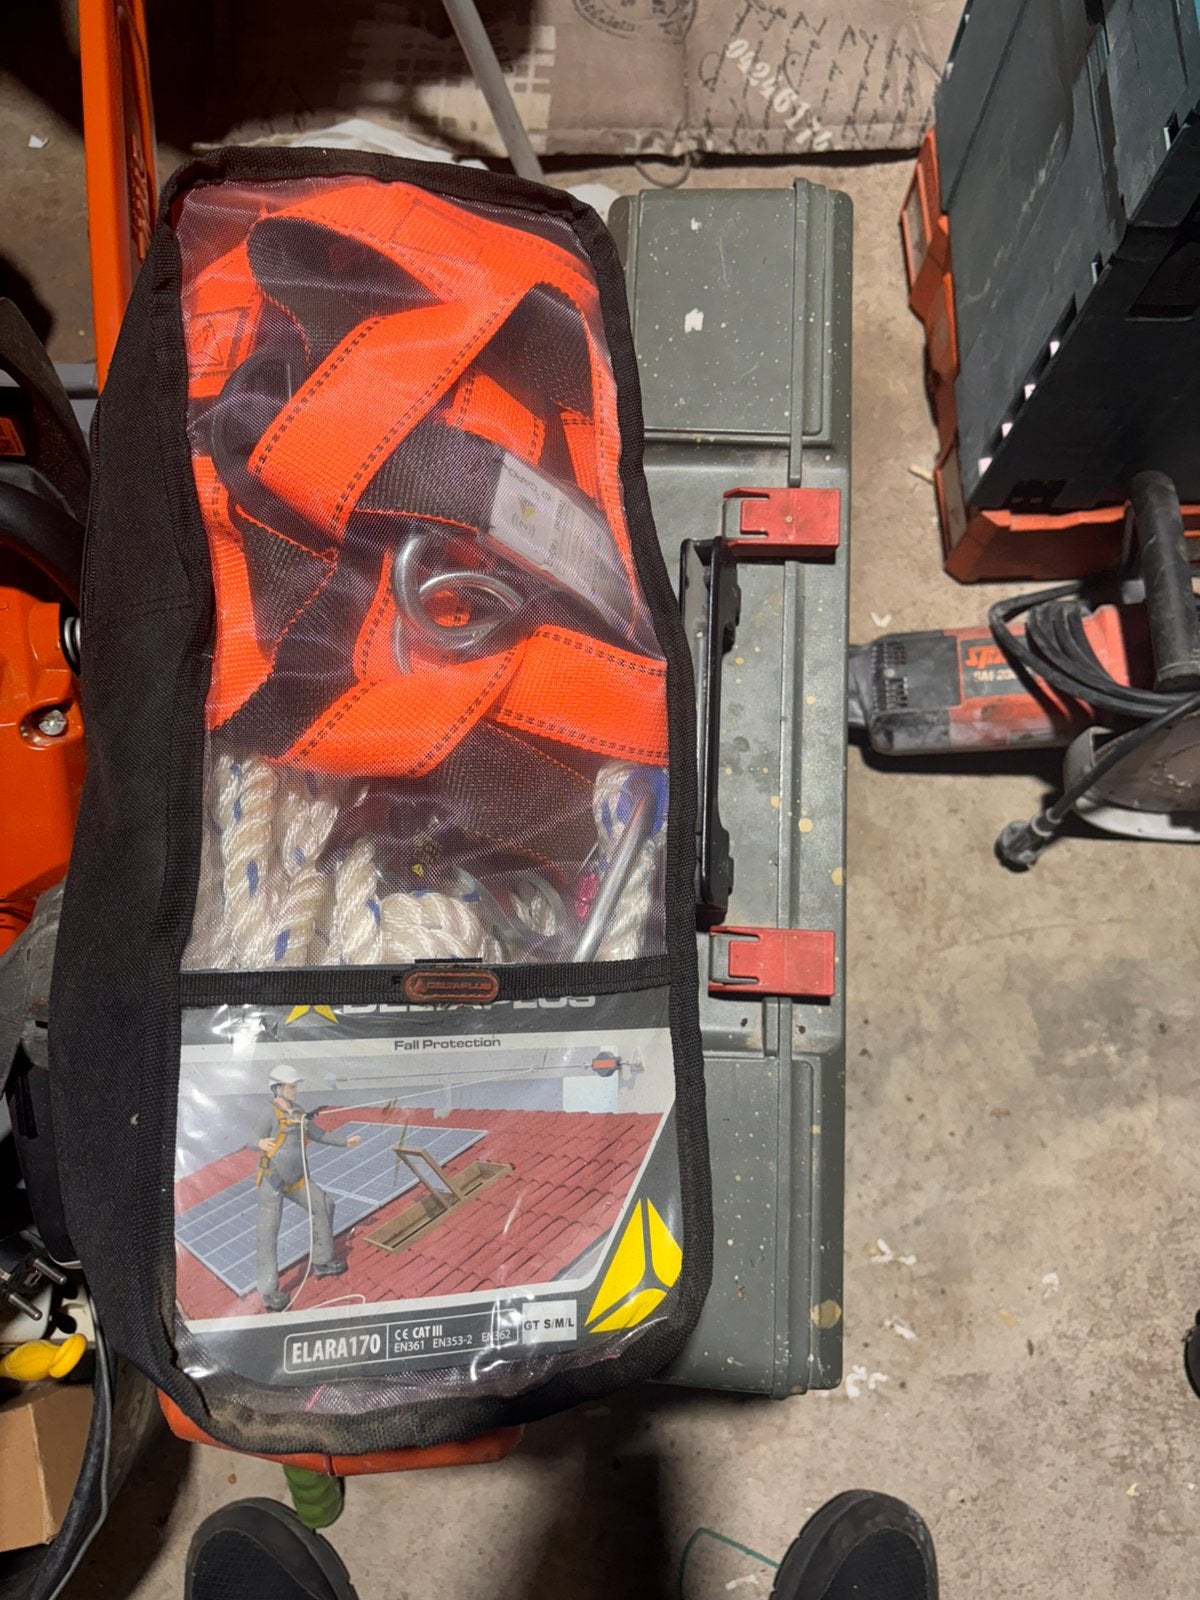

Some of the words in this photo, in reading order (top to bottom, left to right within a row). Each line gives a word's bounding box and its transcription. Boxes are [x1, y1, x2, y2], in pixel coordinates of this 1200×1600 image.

[394, 1039, 419, 1050] Fall
[422, 1037, 501, 1050] Protection
[523, 1320, 540, 1331] GT
[544, 1317, 575, 1329] S/M/L
[394, 1328, 408, 1341] CE
[412, 1327, 430, 1339] CAT
[432, 1325, 443, 1337] III
[394, 1341, 425, 1353] EN361
[433, 1335, 473, 1348] EN353-2
[481, 1329, 511, 1343] EN362
[292, 1333, 381, 1364] ELARA170
